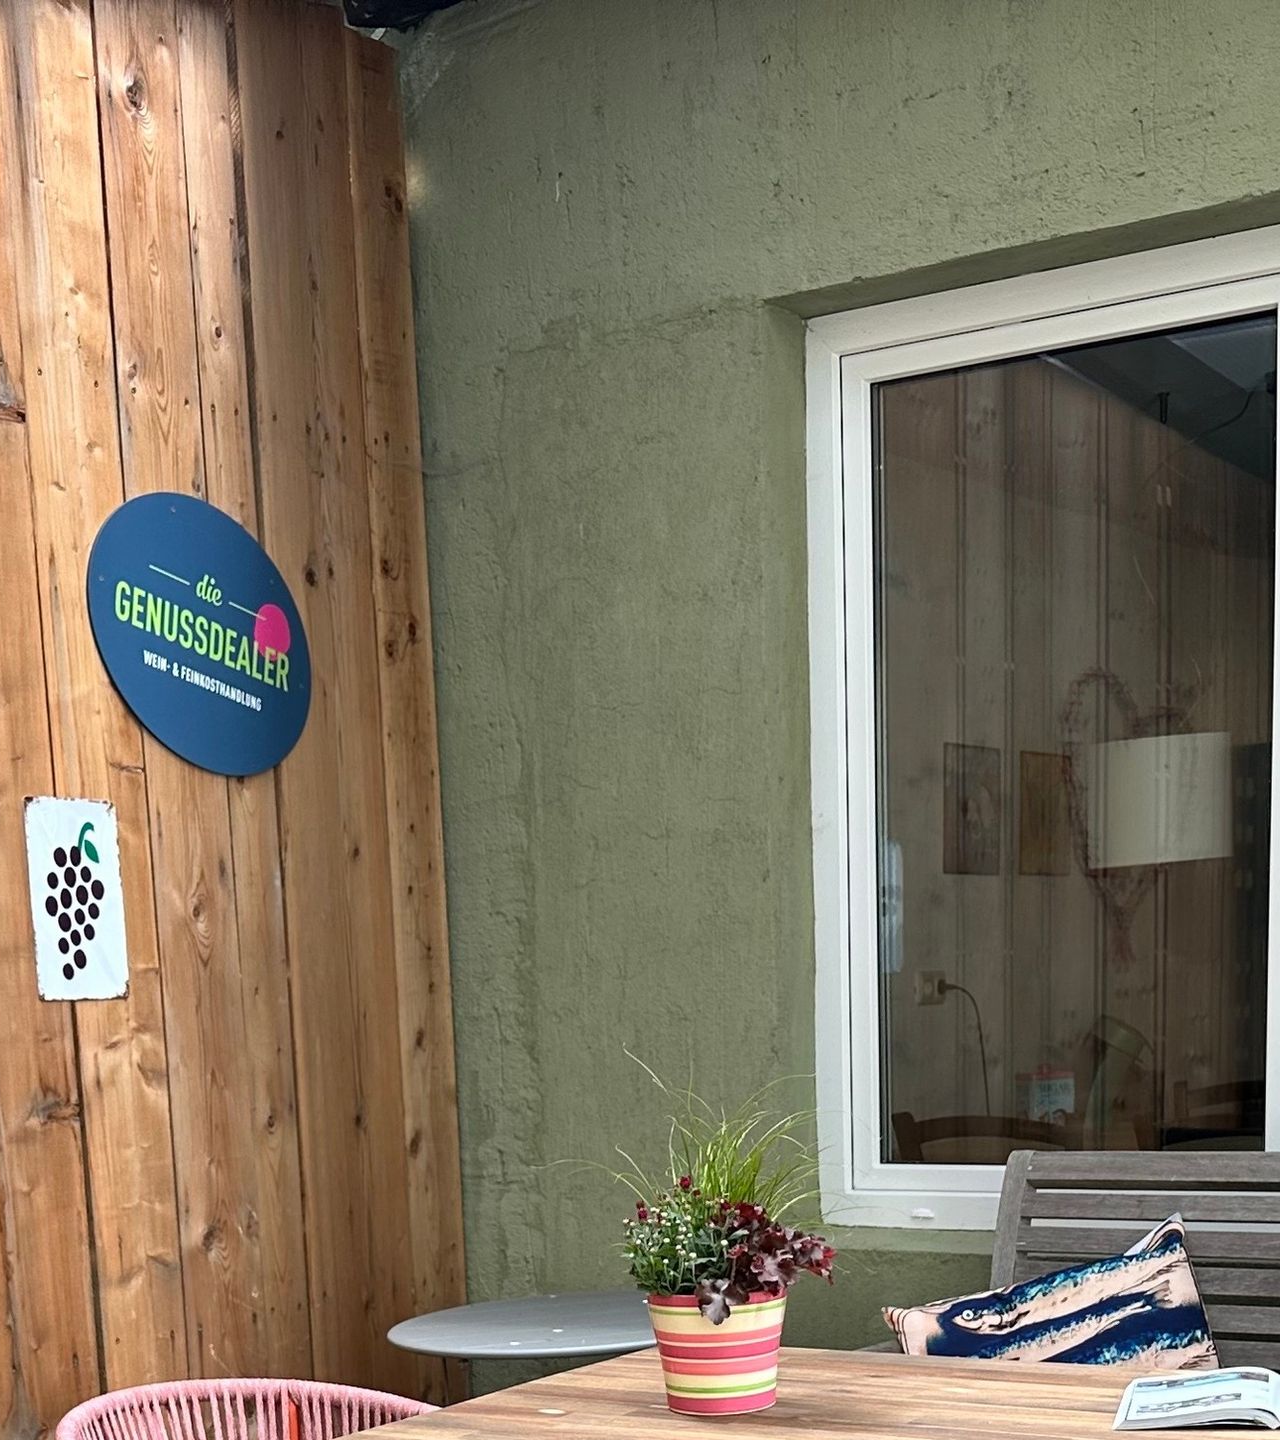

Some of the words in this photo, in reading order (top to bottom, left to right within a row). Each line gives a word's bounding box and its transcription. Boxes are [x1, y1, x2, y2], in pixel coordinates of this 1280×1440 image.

[196, 574, 222, 606] die
[114, 581, 289, 693] GENUSSDEALER
[143, 649, 170, 673] WEIN-
[172, 661, 180, 677] &
[180, 665, 262, 712] FEINKOSTHANDLUNG
